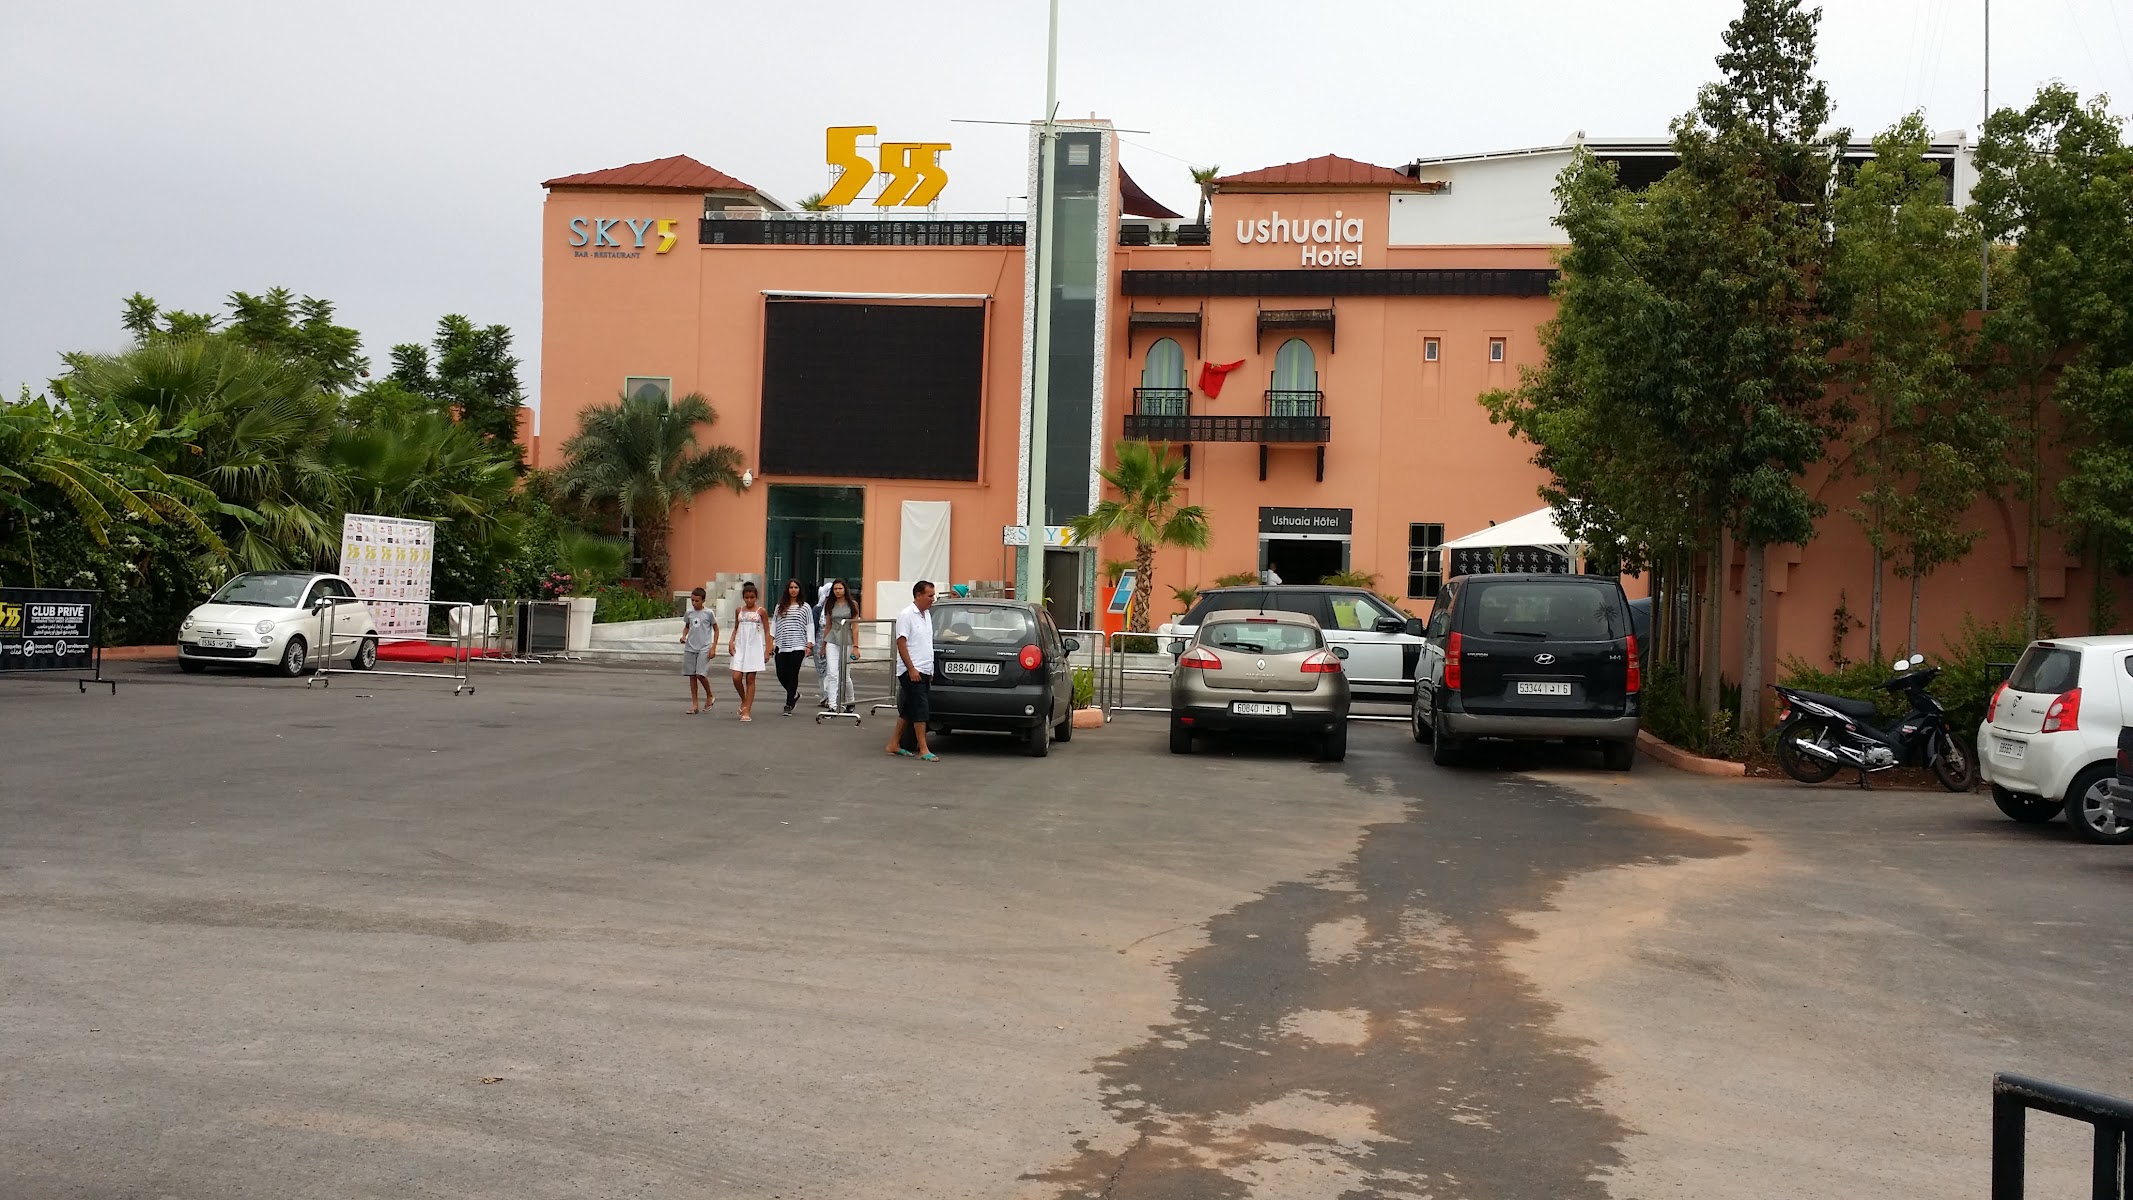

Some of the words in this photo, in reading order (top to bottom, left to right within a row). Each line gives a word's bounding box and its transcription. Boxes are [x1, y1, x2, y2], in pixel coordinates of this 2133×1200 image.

[1236, 210, 1364, 244] ushuaia
[574, 250, 589, 258] BAR
[594, 251, 641, 259] RESTAURANT
[1301, 244, 1363, 267] Hotel
[1272, 515, 1311, 526] Ushuaia
[1313, 516, 1339, 527] Hôtel
[32, 606, 56, 616] CLUB
[57, 605, 84, 616] PRIVÉ
[947, 663, 975, 673] 88840
[985, 664, 997, 674] 40
[1519, 683, 1542, 693] 53344
[1563, 684, 1568, 694] 6
[1237, 703, 1259, 713] 60840
